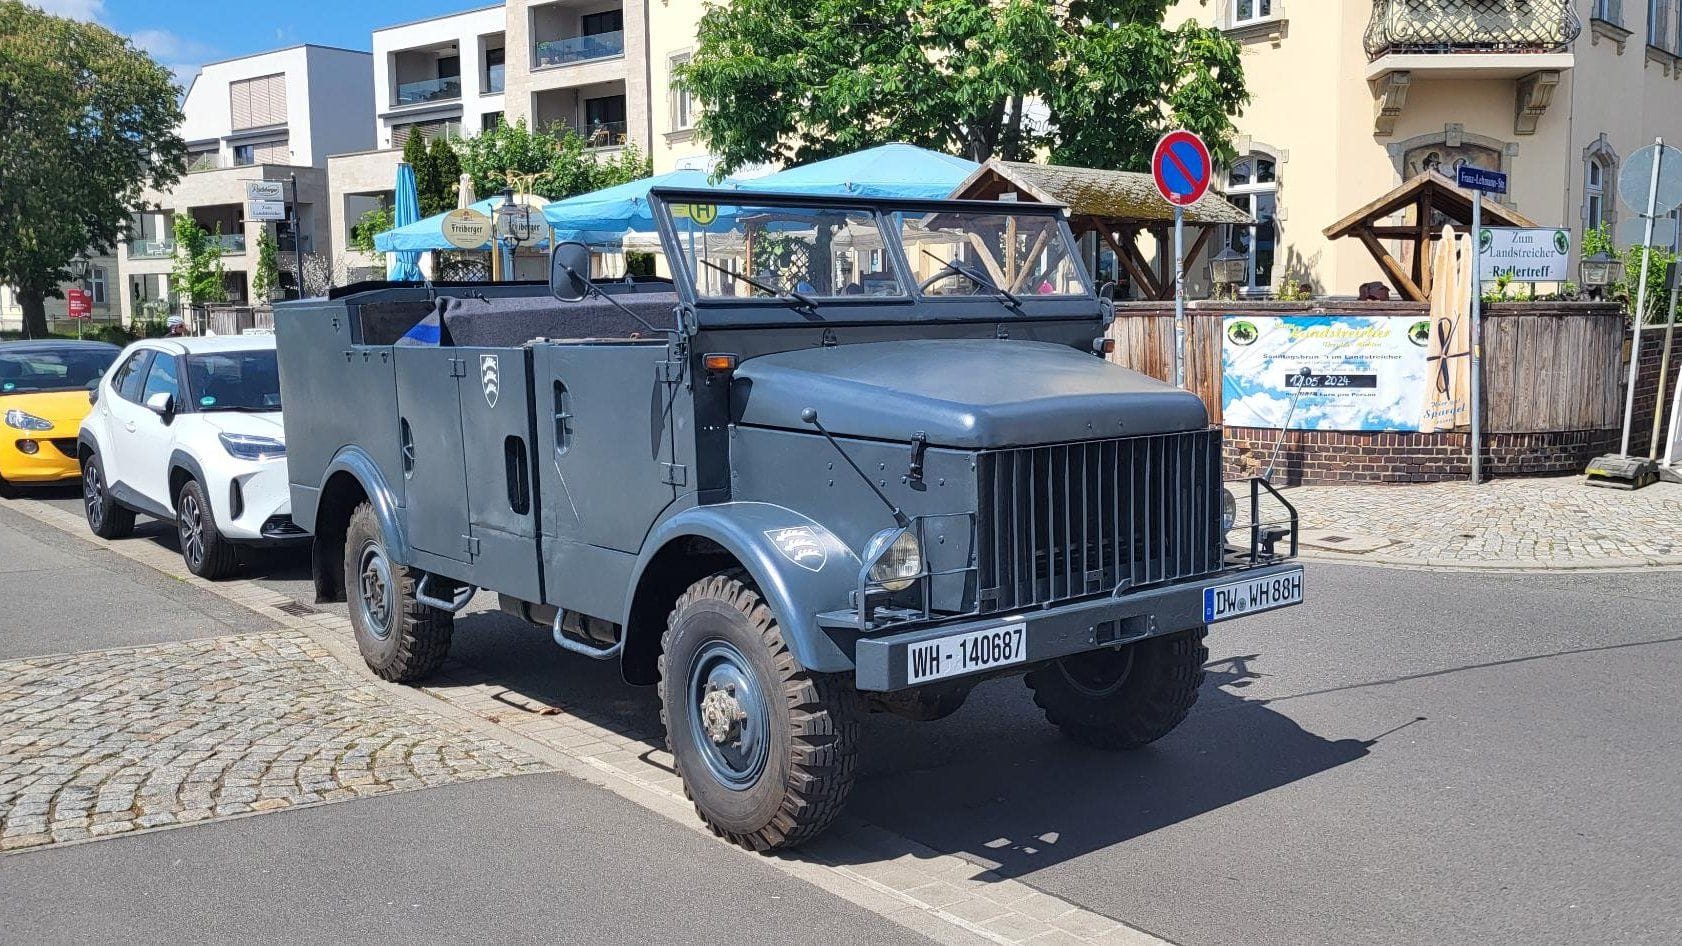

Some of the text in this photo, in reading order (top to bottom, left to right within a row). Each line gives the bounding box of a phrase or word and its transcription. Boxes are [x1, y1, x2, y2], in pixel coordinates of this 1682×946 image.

[451, 223, 483, 235] Freiberger
[508, 222, 541, 234] reibeger
[1511, 231, 1534, 244] Zum
[1490, 246, 1555, 259] Landstreicher
[1324, 374, 1352, 386] 2024
[1423, 402, 1466, 419] Spargel
[1216, 588, 1238, 615] DW
[912, 645, 940, 679] WH
[960, 629, 1023, 669] 140687
